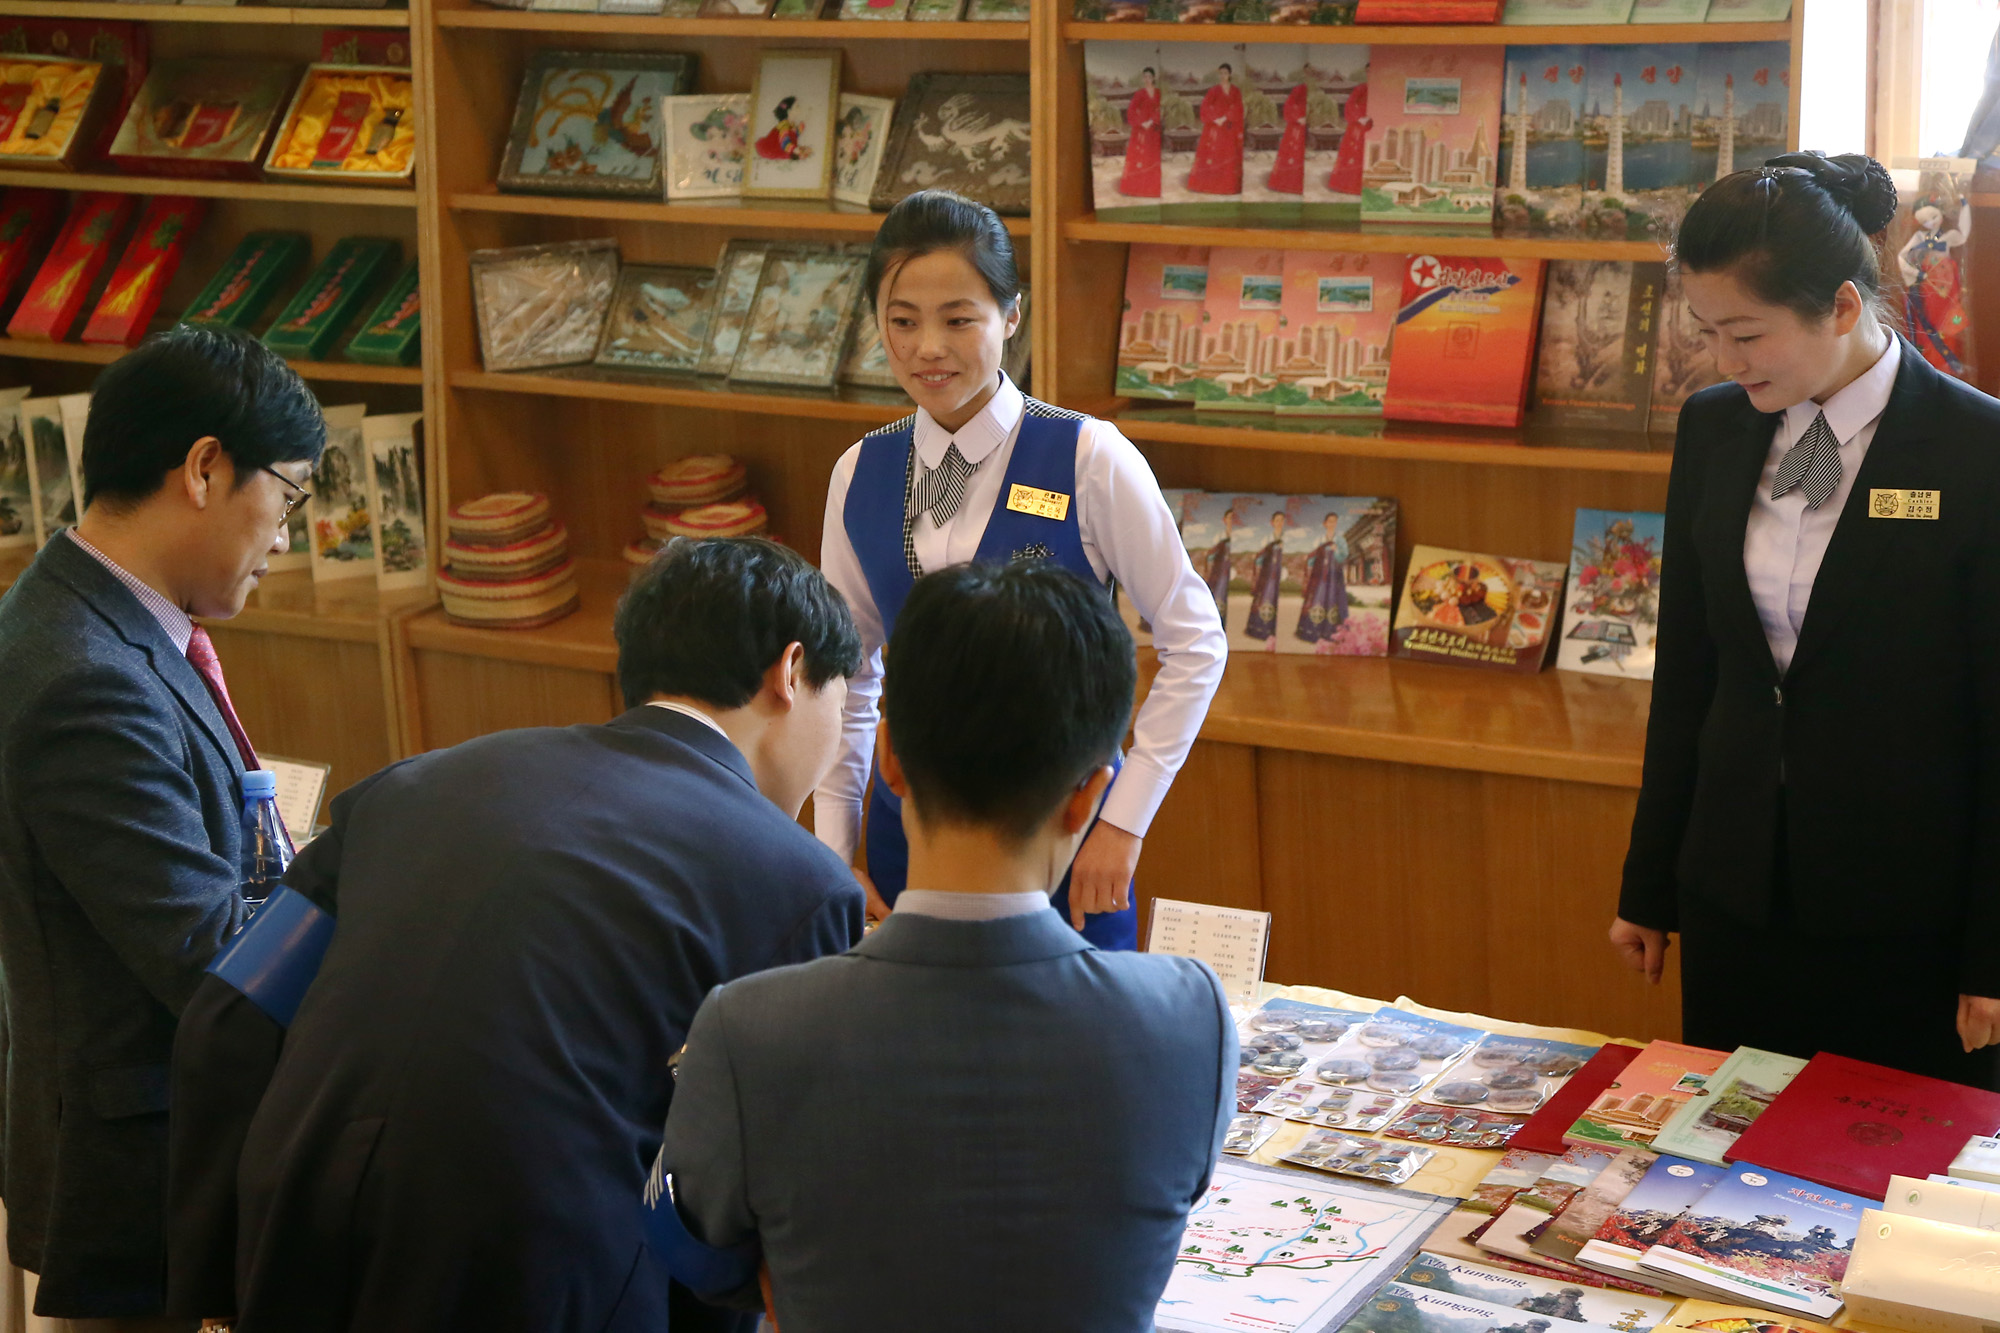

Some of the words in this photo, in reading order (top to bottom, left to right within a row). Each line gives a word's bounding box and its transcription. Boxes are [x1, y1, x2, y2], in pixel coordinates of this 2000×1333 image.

[1640, 65, 1683, 85] 평양
[1773, 1193, 1803, 1205] Nature
[1451, 1265, 1529, 1289] Kumgang
[1417, 1294, 1496, 1319] Kumgang
